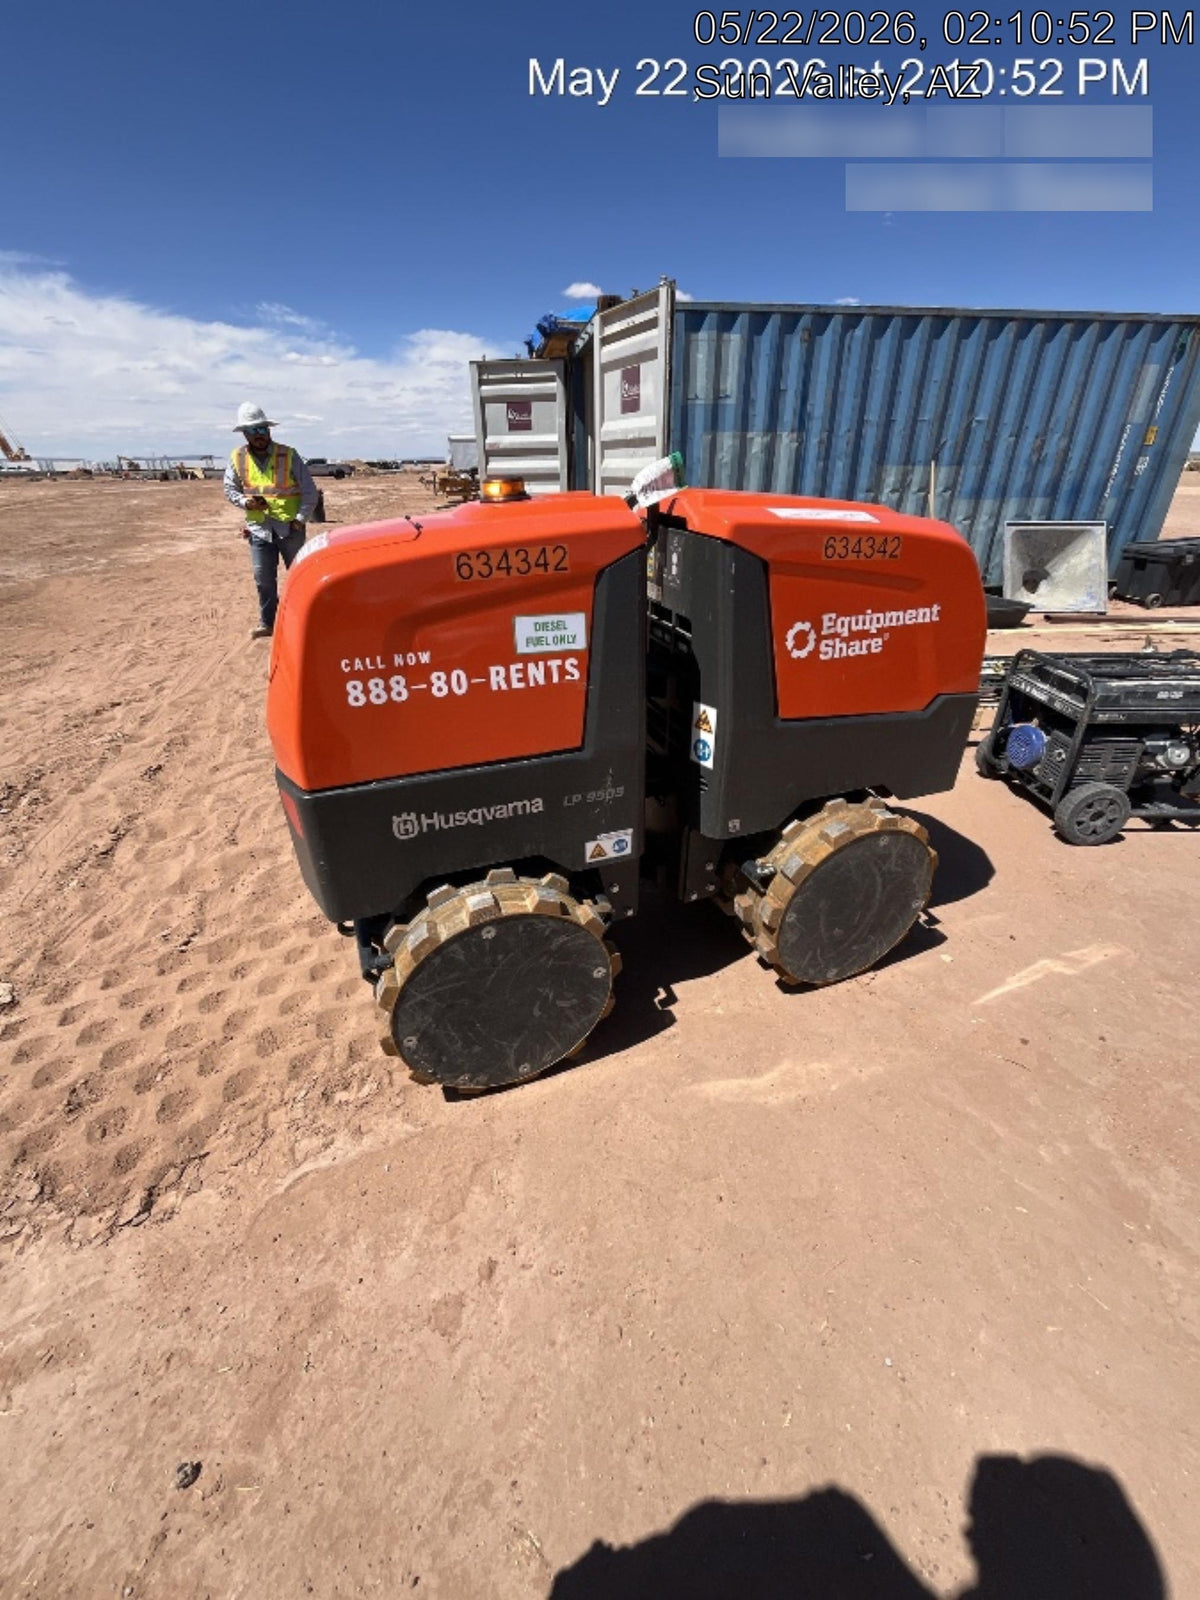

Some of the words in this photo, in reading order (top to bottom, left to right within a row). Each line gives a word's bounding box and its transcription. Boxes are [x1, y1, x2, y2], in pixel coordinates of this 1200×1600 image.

[824, 536, 901, 559] 634342
[456, 545, 569, 580] 634342
[534, 620, 568, 632] DIESEL
[820, 603, 941, 637] Equipment
[525, 636, 551, 648] FUEL
[552, 634, 577, 646] ONLY
[340, 655, 386, 672] CALL
[393, 651, 431, 667] NOW
[345, 657, 581, 707] 888-80-RENTS
[563, 793, 582, 807] LP
[421, 798, 544, 833] Husqvarna
